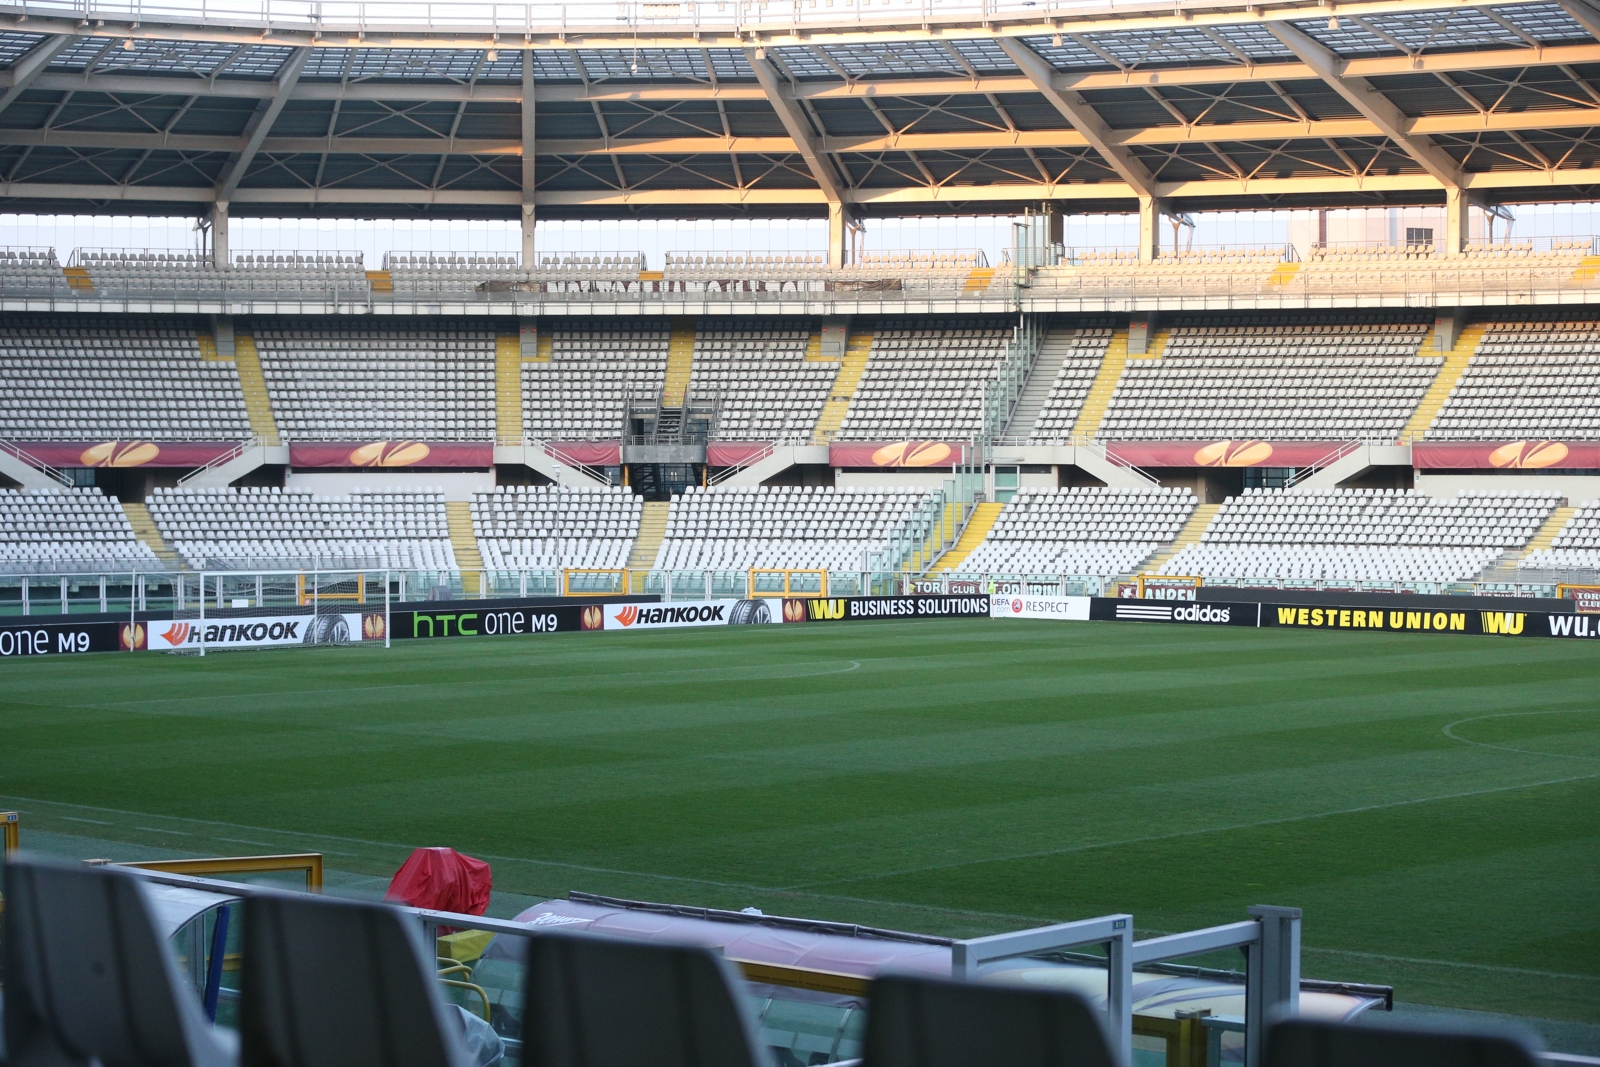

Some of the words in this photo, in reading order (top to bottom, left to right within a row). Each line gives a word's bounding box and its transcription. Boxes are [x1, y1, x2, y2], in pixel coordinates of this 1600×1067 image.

[952, 585, 975, 594] CLUB
[1576, 592, 1600, 600] TOR
[851, 599, 914, 617] BUSINESS
[917, 598, 988, 615] SOLUTIONS
[1026, 601, 1069, 613] RESPECT
[1173, 604, 1230, 623] adidas
[485, 612, 525, 635] one
[531, 614, 558, 632] M9
[1277, 607, 1384, 628] WESTERN
[1389, 611, 1465, 631] UNION
[0, 630, 49, 656] one
[58, 632, 90, 653] M9
